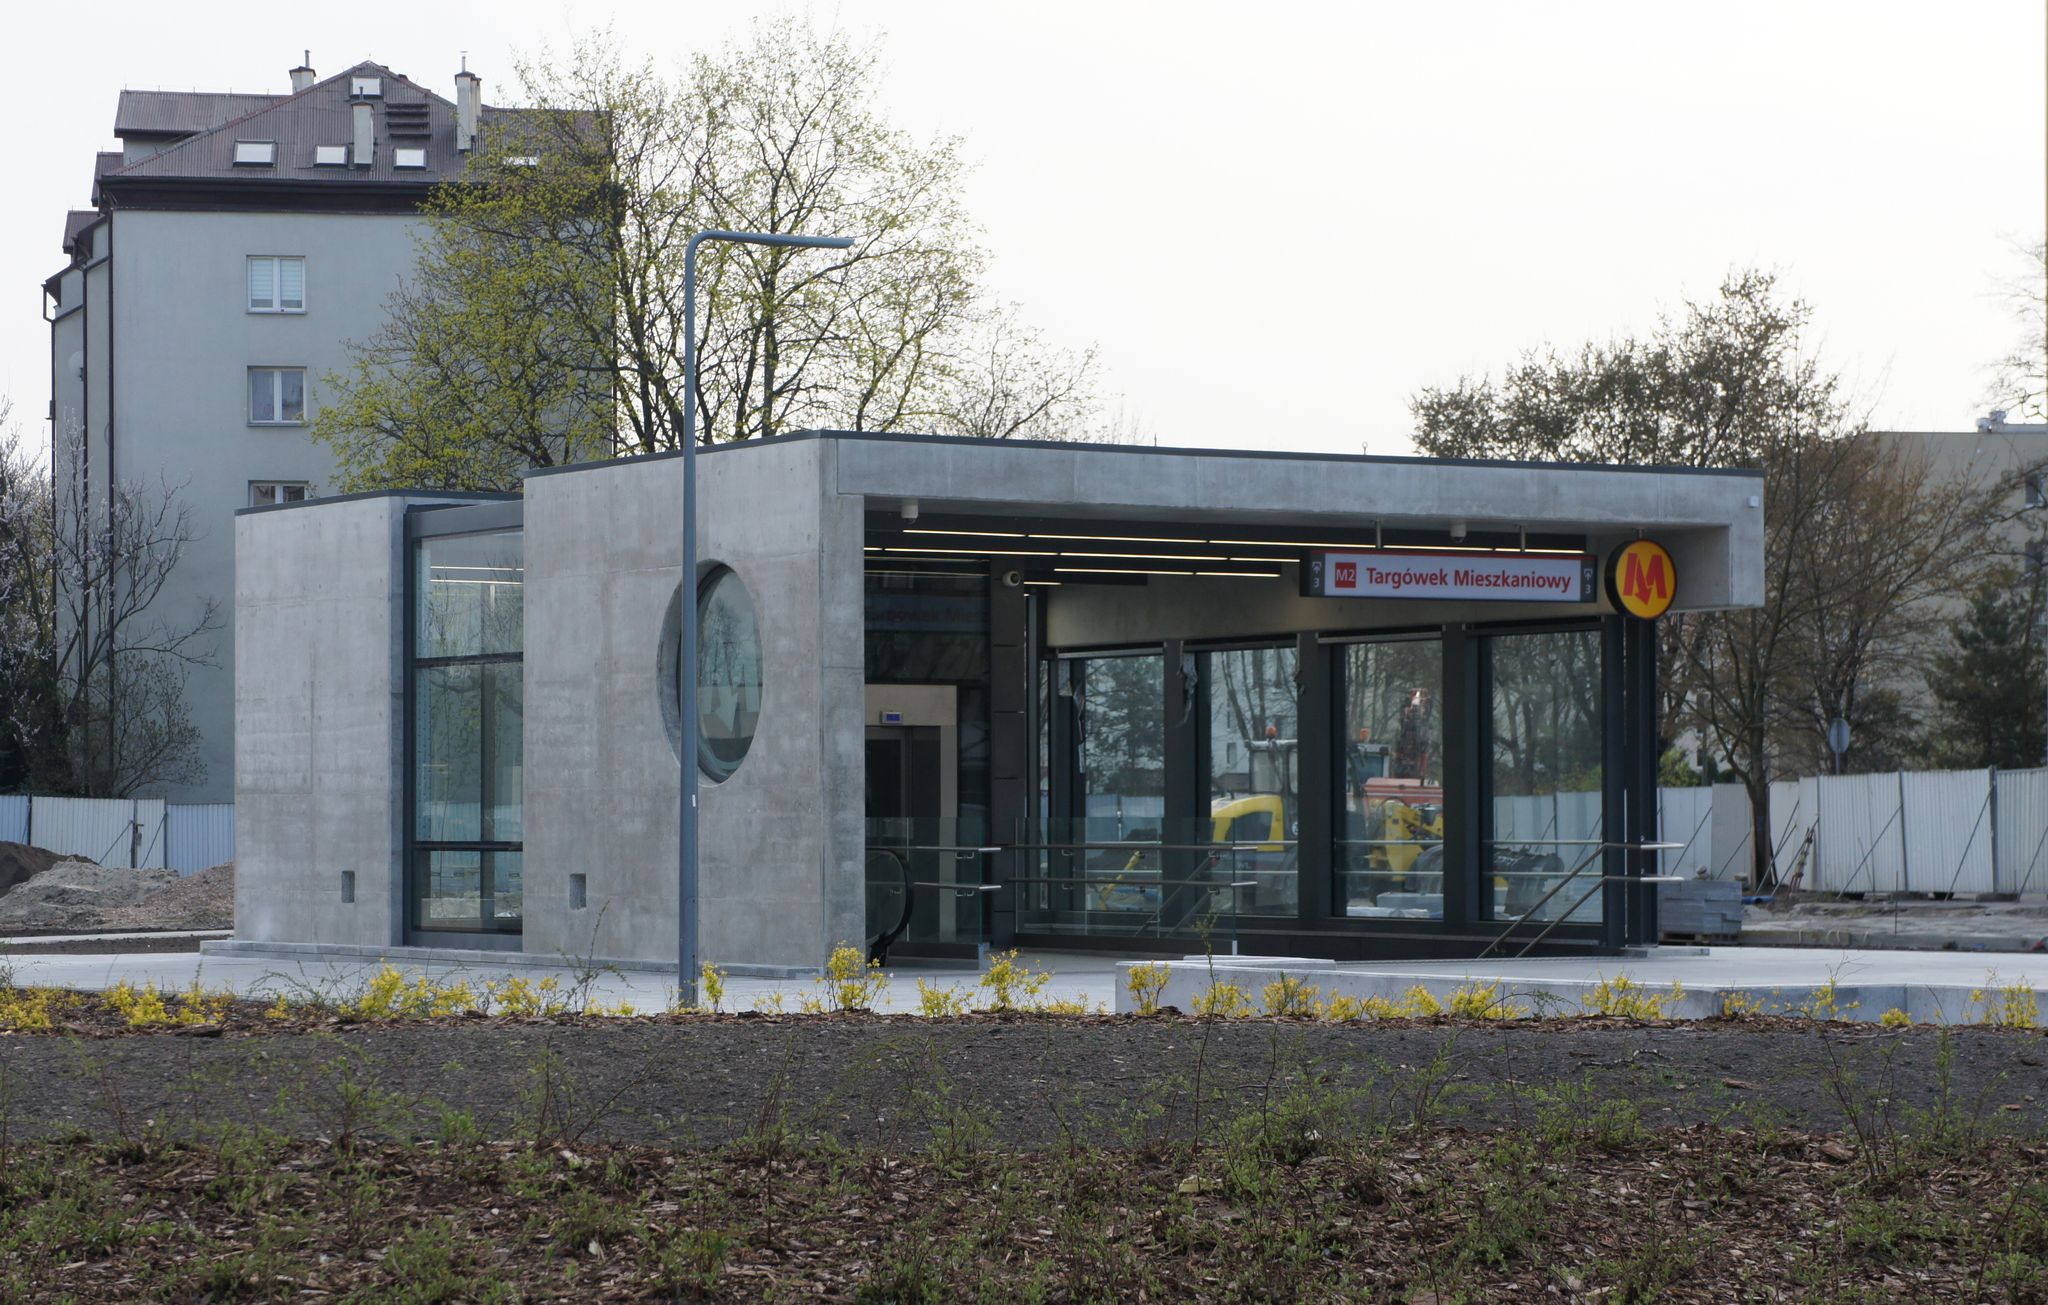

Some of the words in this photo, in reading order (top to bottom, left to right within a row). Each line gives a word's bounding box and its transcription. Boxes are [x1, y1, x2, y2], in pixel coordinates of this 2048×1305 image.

[1313, 577, 1320, 588] 3
[1335, 568, 1356, 582] M2
[1366, 567, 1448, 589] Targówek
[1454, 569, 1571, 593] Mieszkaniowy
[1623, 552, 1668, 606] M
[1585, 583, 1591, 594] 3
